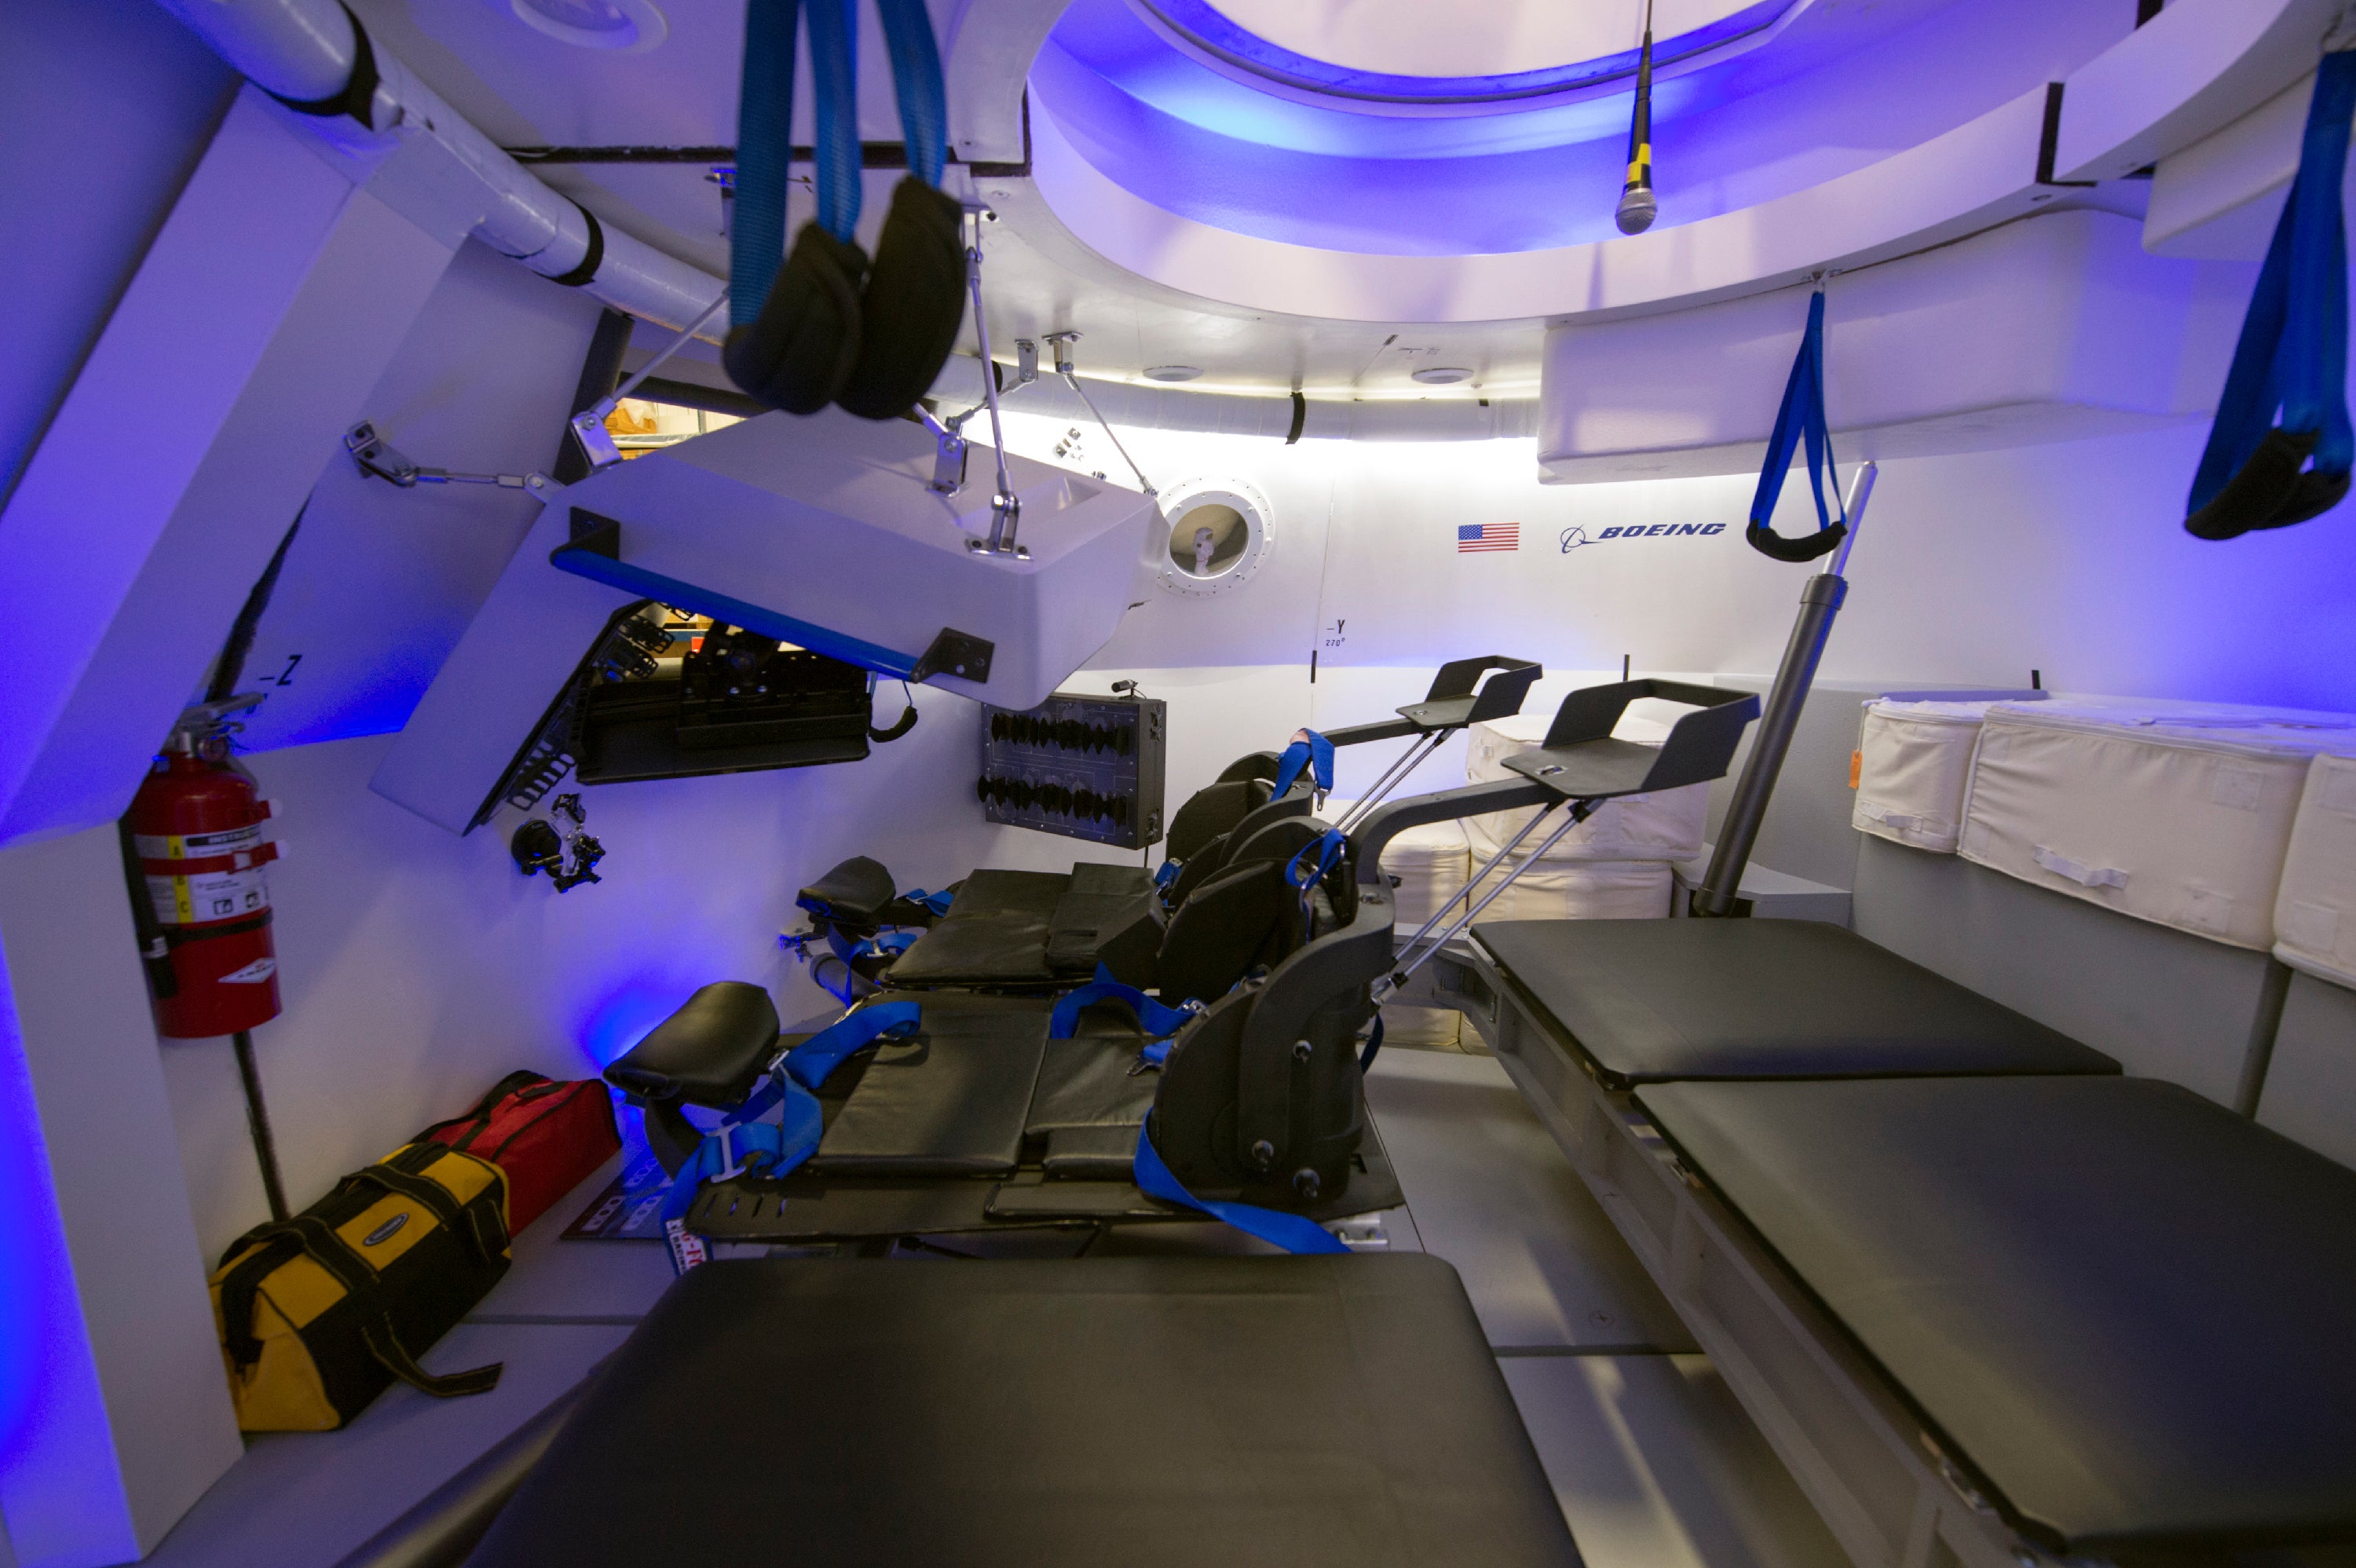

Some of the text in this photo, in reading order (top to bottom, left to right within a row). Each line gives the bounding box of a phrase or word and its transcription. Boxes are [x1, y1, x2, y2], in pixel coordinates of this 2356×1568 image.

[1597, 523, 1727, 539] BOEING
[1326, 619, 1345, 634] -Y
[258, 654, 302, 685] -Z
